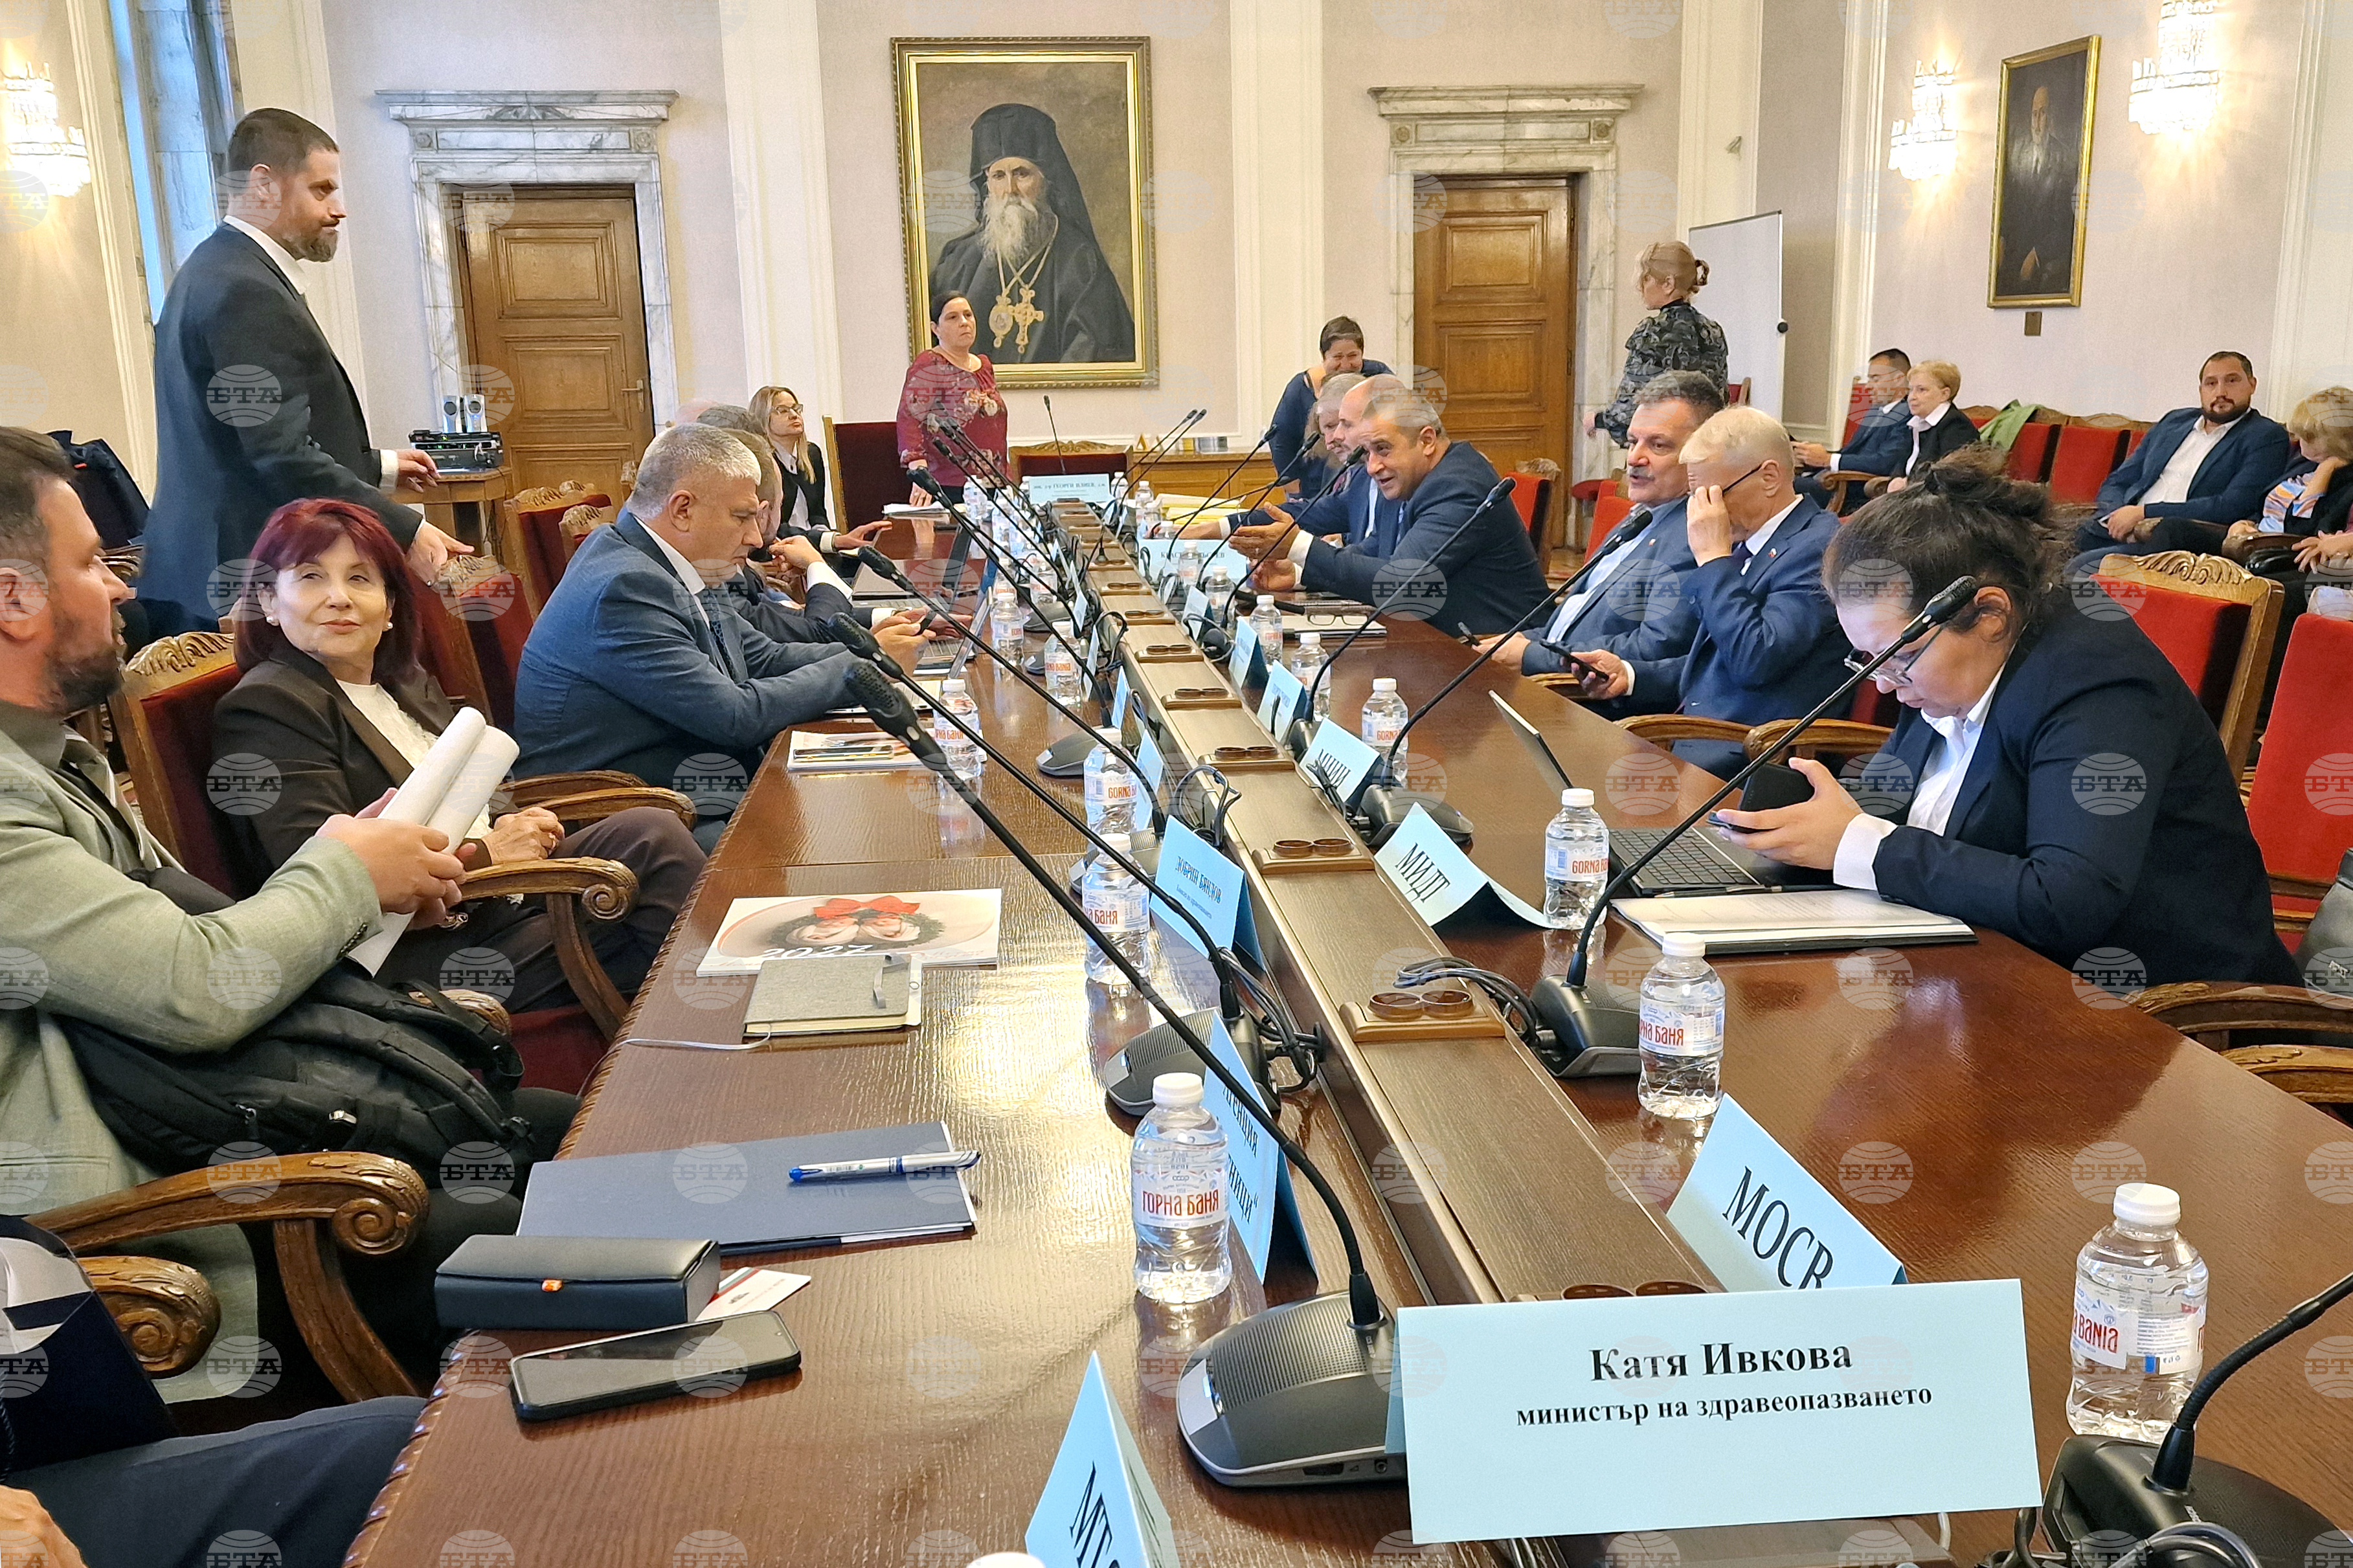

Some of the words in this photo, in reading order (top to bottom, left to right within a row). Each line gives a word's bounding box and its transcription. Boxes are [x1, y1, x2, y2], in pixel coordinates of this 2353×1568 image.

[1395, 842, 1450, 903] МИДТ
[1590, 1349, 1688, 1381] Катя
[1703, 1343, 1852, 1375] Ивкова
[1517, 1404, 1649, 1426] министър
[1658, 1401, 1689, 1418] на
[1696, 1388, 1932, 1421] здравеопазването
[1070, 1460, 1120, 1568] МТ
